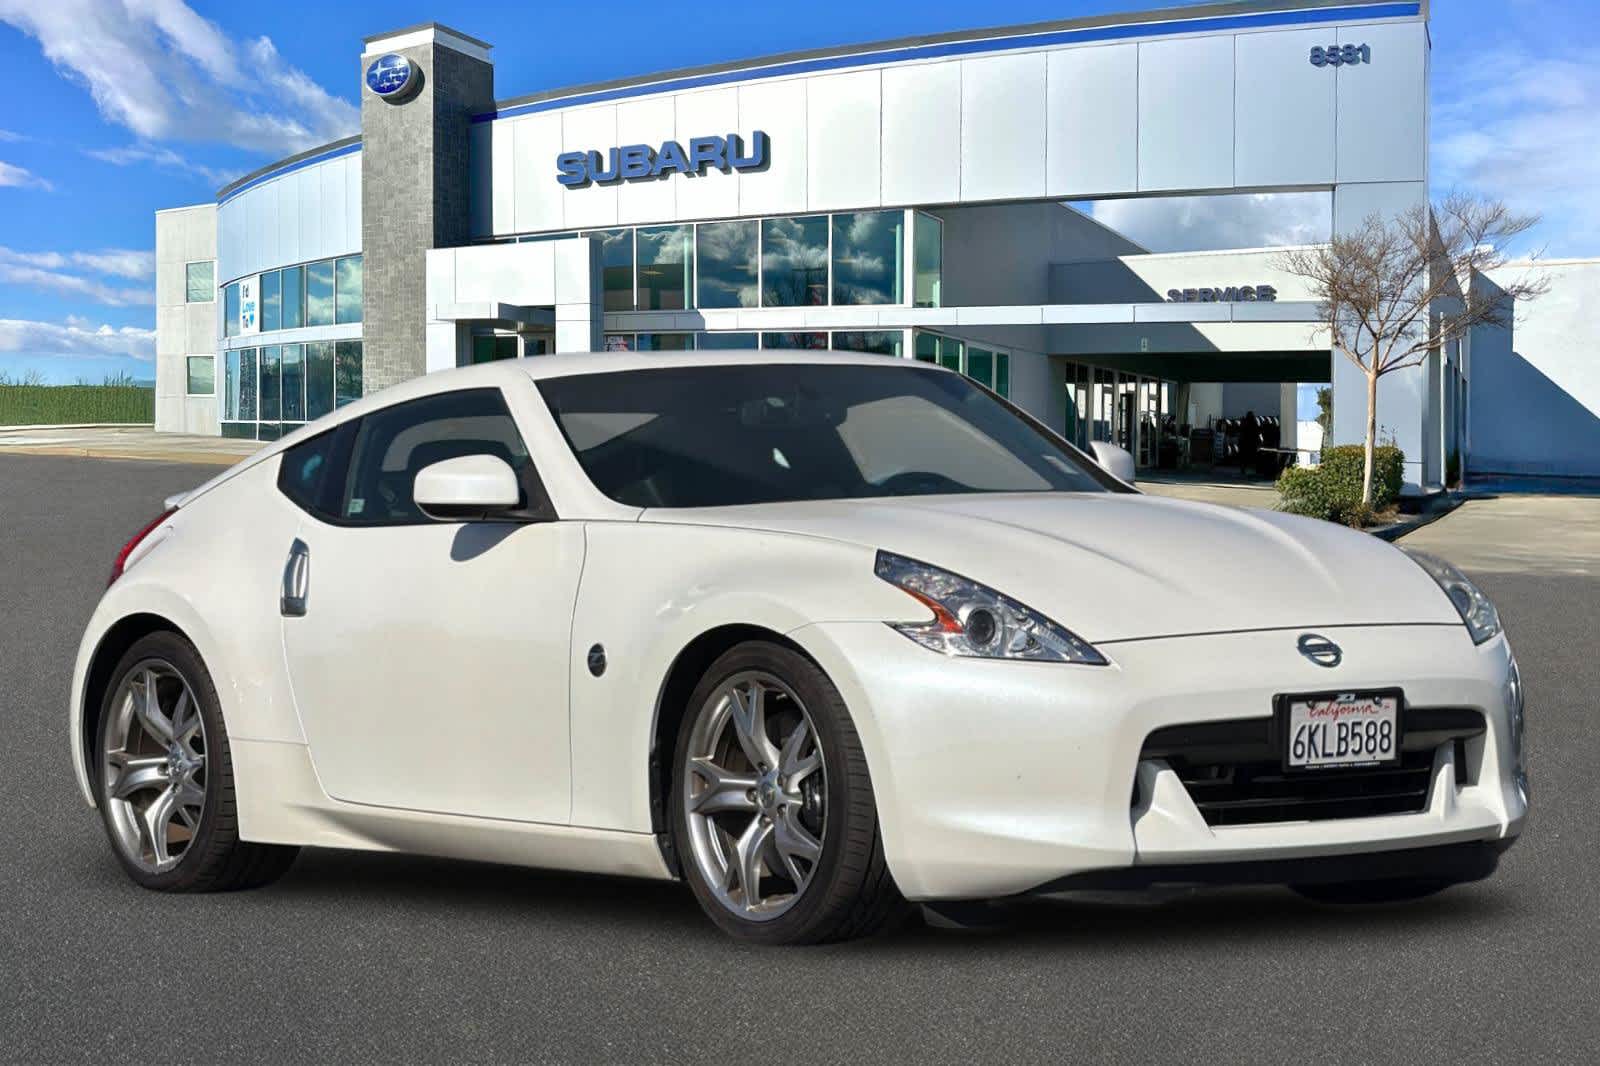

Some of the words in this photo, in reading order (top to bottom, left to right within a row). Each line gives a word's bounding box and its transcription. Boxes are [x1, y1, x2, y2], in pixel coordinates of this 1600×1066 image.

[556, 130, 770, 189] SUBARU
[1166, 285, 1277, 302] SERVICE
[1306, 699, 1377, 720] California
[1292, 720, 1392, 759] 6KLB588
